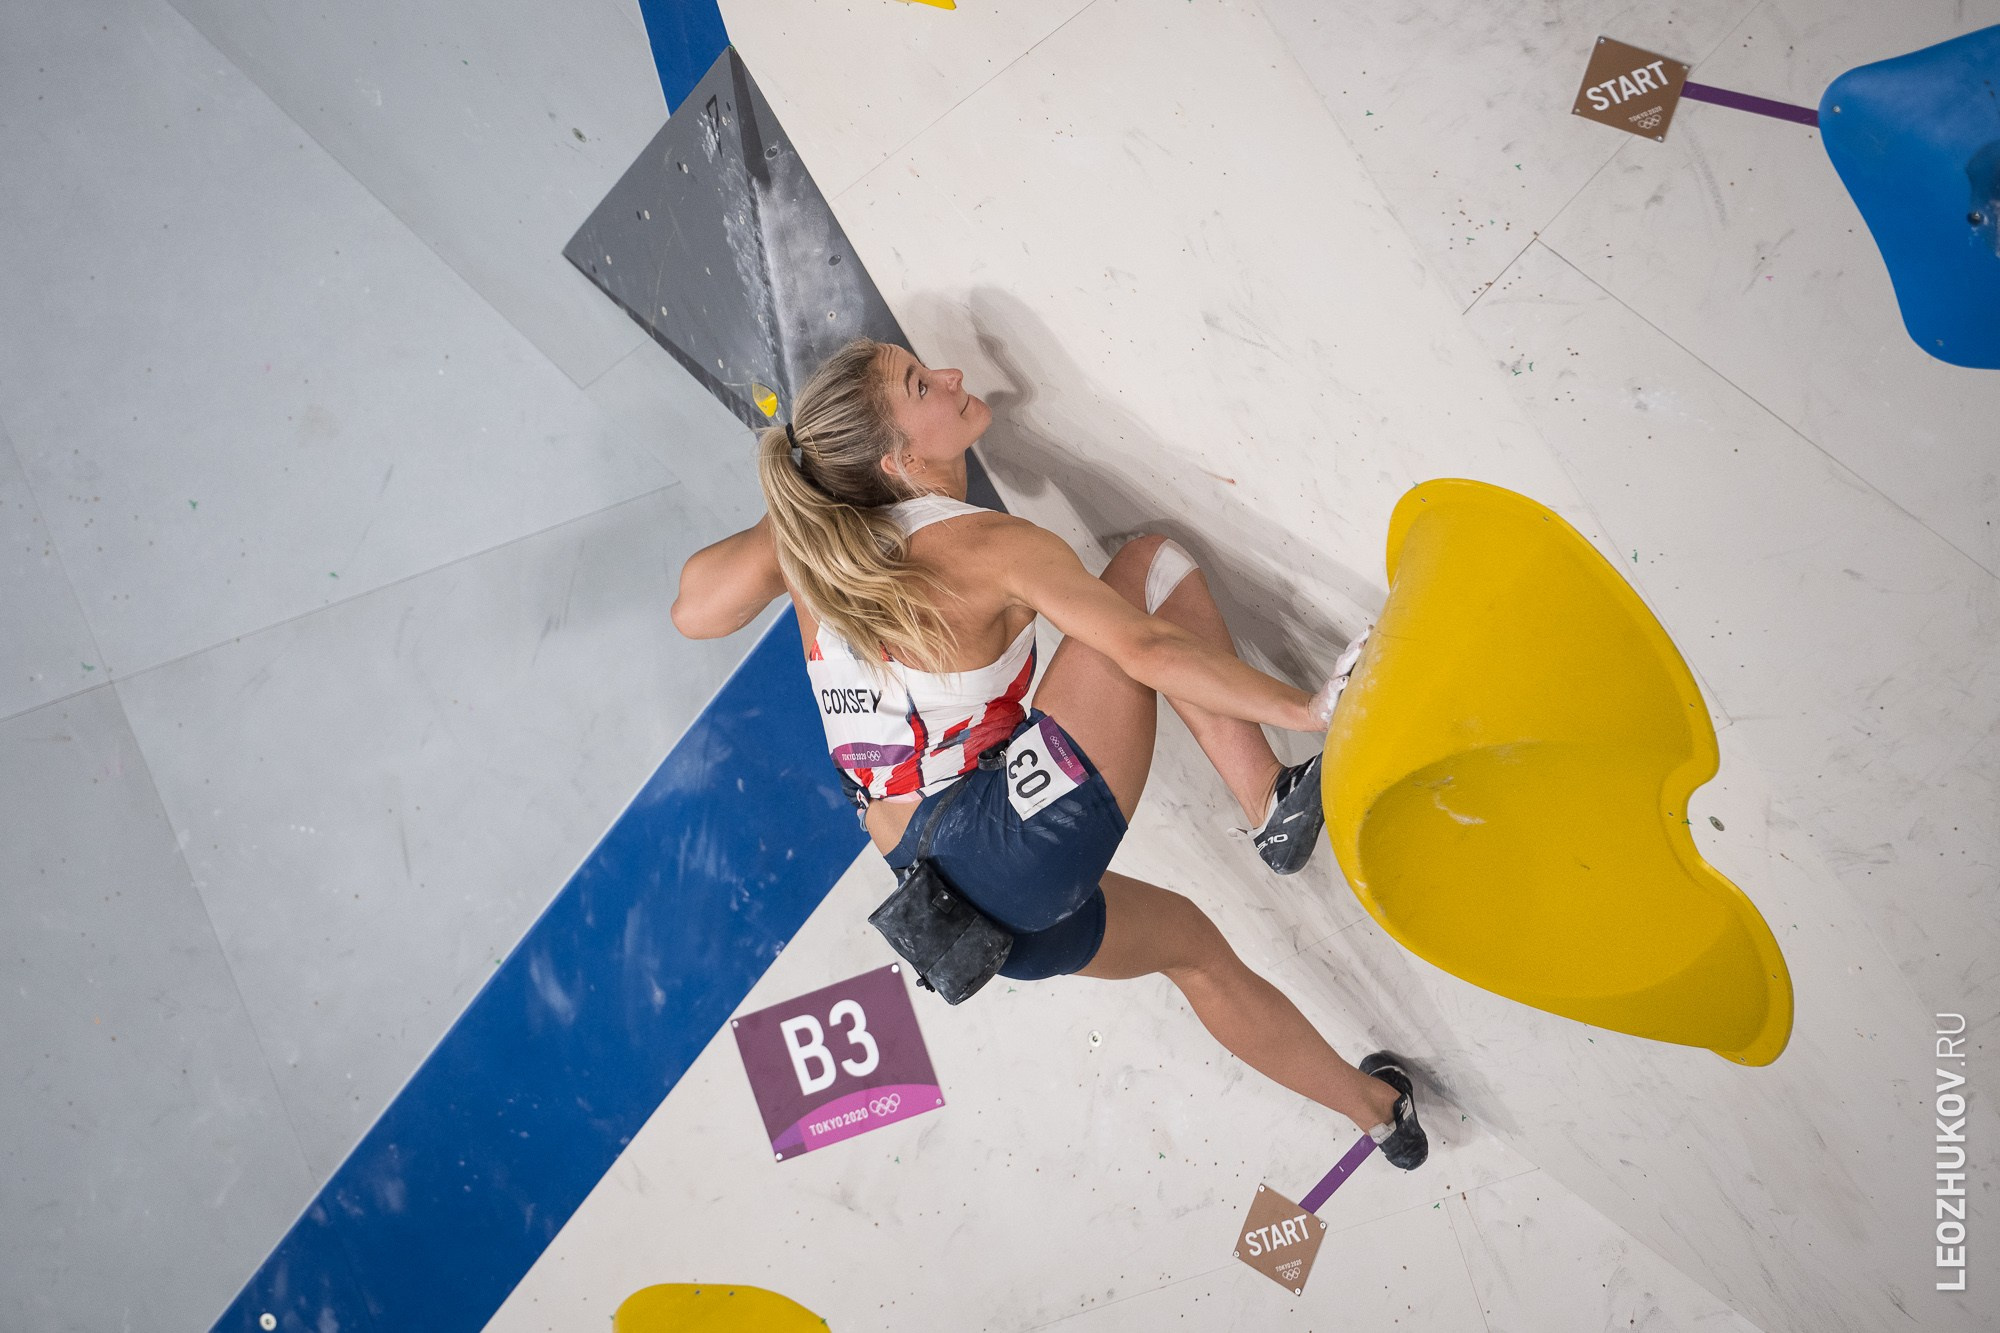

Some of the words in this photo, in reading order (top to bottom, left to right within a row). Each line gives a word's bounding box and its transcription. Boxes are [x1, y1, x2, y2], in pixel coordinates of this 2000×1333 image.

[1586, 60, 1669, 111] START
[821, 688, 883, 715] COXSEY
[1008, 749, 1051, 799] 03
[780, 999, 880, 1096] B3
[808, 1115, 843, 1136] TOKYO
[844, 1106, 869, 1125] 2020
[1245, 1214, 1309, 1257] START
[1275, 1262, 1291, 1273] TOKYO
[1290, 1258, 1302, 1268] 2020
